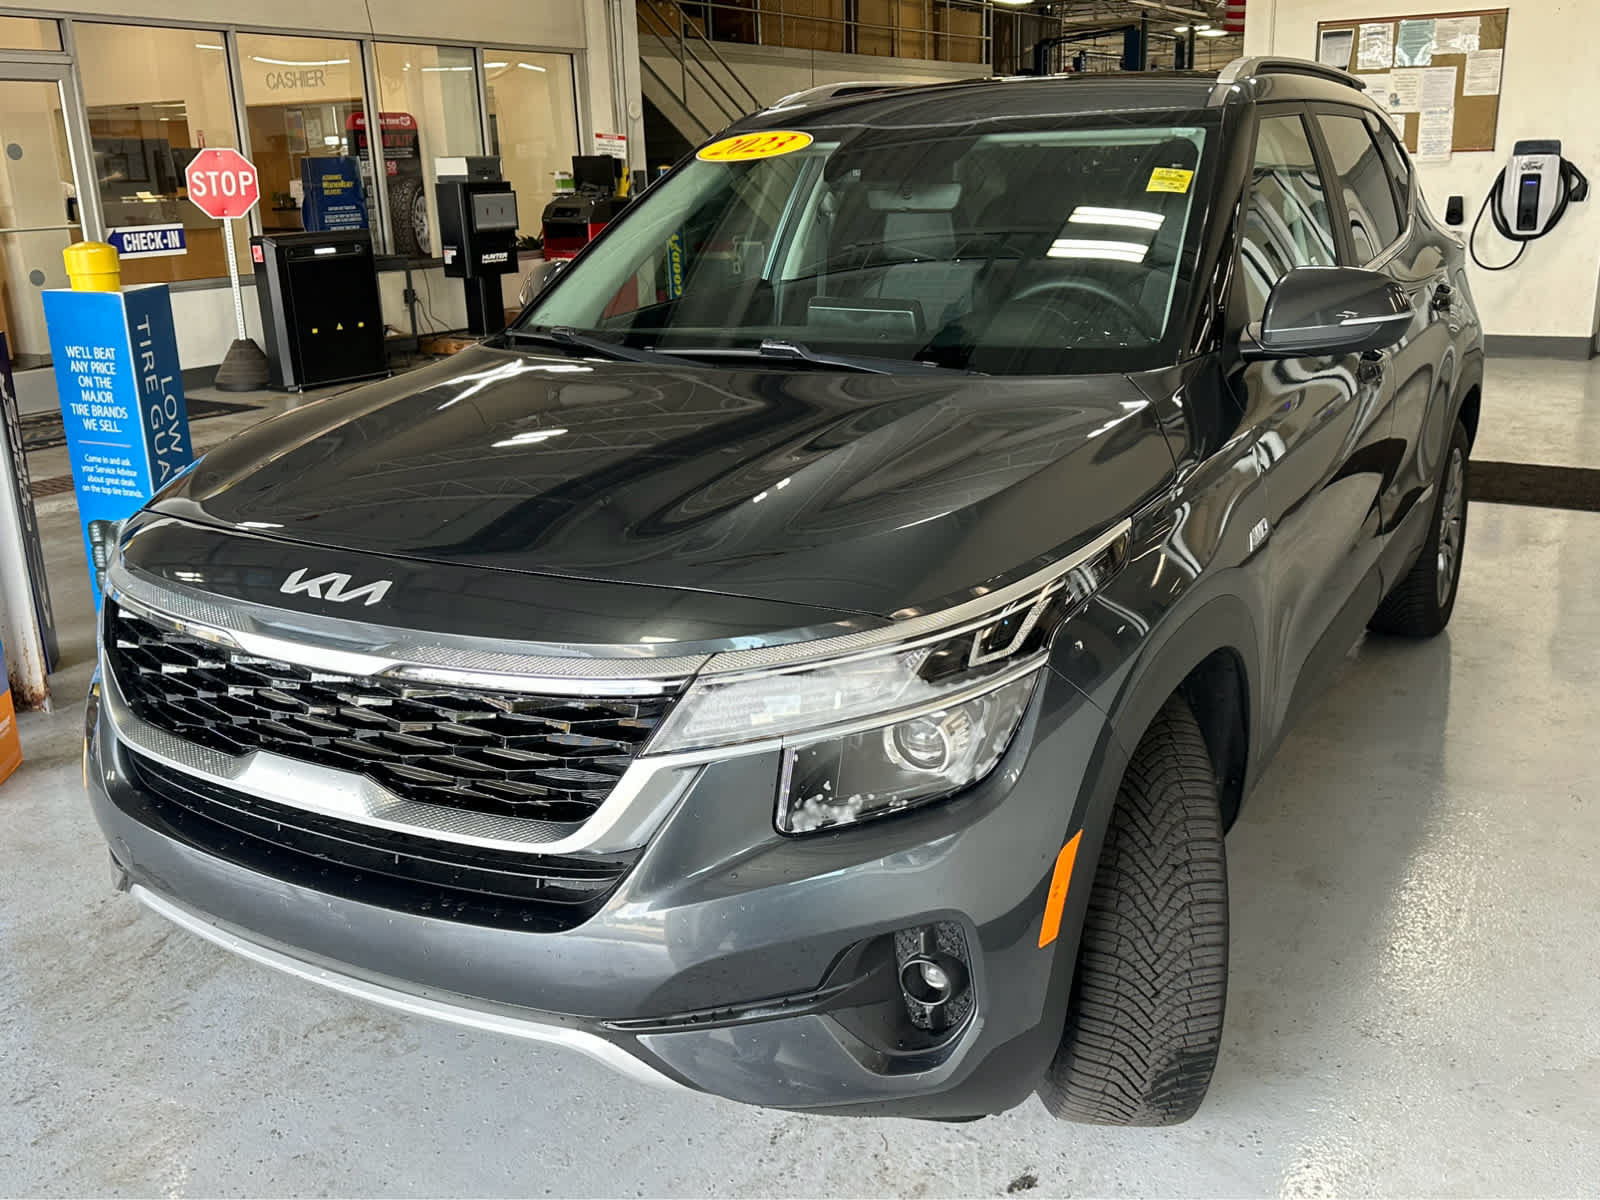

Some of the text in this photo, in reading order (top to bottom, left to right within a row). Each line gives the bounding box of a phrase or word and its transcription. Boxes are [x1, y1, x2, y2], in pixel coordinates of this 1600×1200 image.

[265, 69, 326, 89] CASHIER
[707, 135, 798, 156] 2023
[1520, 160, 1544, 171] Ford
[191, 171, 253, 197] STOP
[122, 230, 180, 252] CHECK-IN
[65, 345, 116, 360] WE'LL BEAT
[136, 313, 160, 395] TIRE
[71, 360, 117, 376] ANY PRICE
[78, 375, 113, 389] ON THE
[81, 389, 115, 404] MAJOR
[70, 402, 129, 419] TIRE BRANDS
[160, 375, 184, 453] LOW
[83, 418, 98, 431] WE
[84, 454, 101, 463] Come
[102, 456, 109, 464] in
[109, 457, 120, 465] and
[81, 464, 138, 477] your Service Advisor
[88, 474, 104, 483] about
[105, 477, 120, 486] great
[90, 484, 100, 493] the
[101, 486, 112, 496] top
[112, 487, 122, 496] tire
[279, 567, 393, 606] KIA
